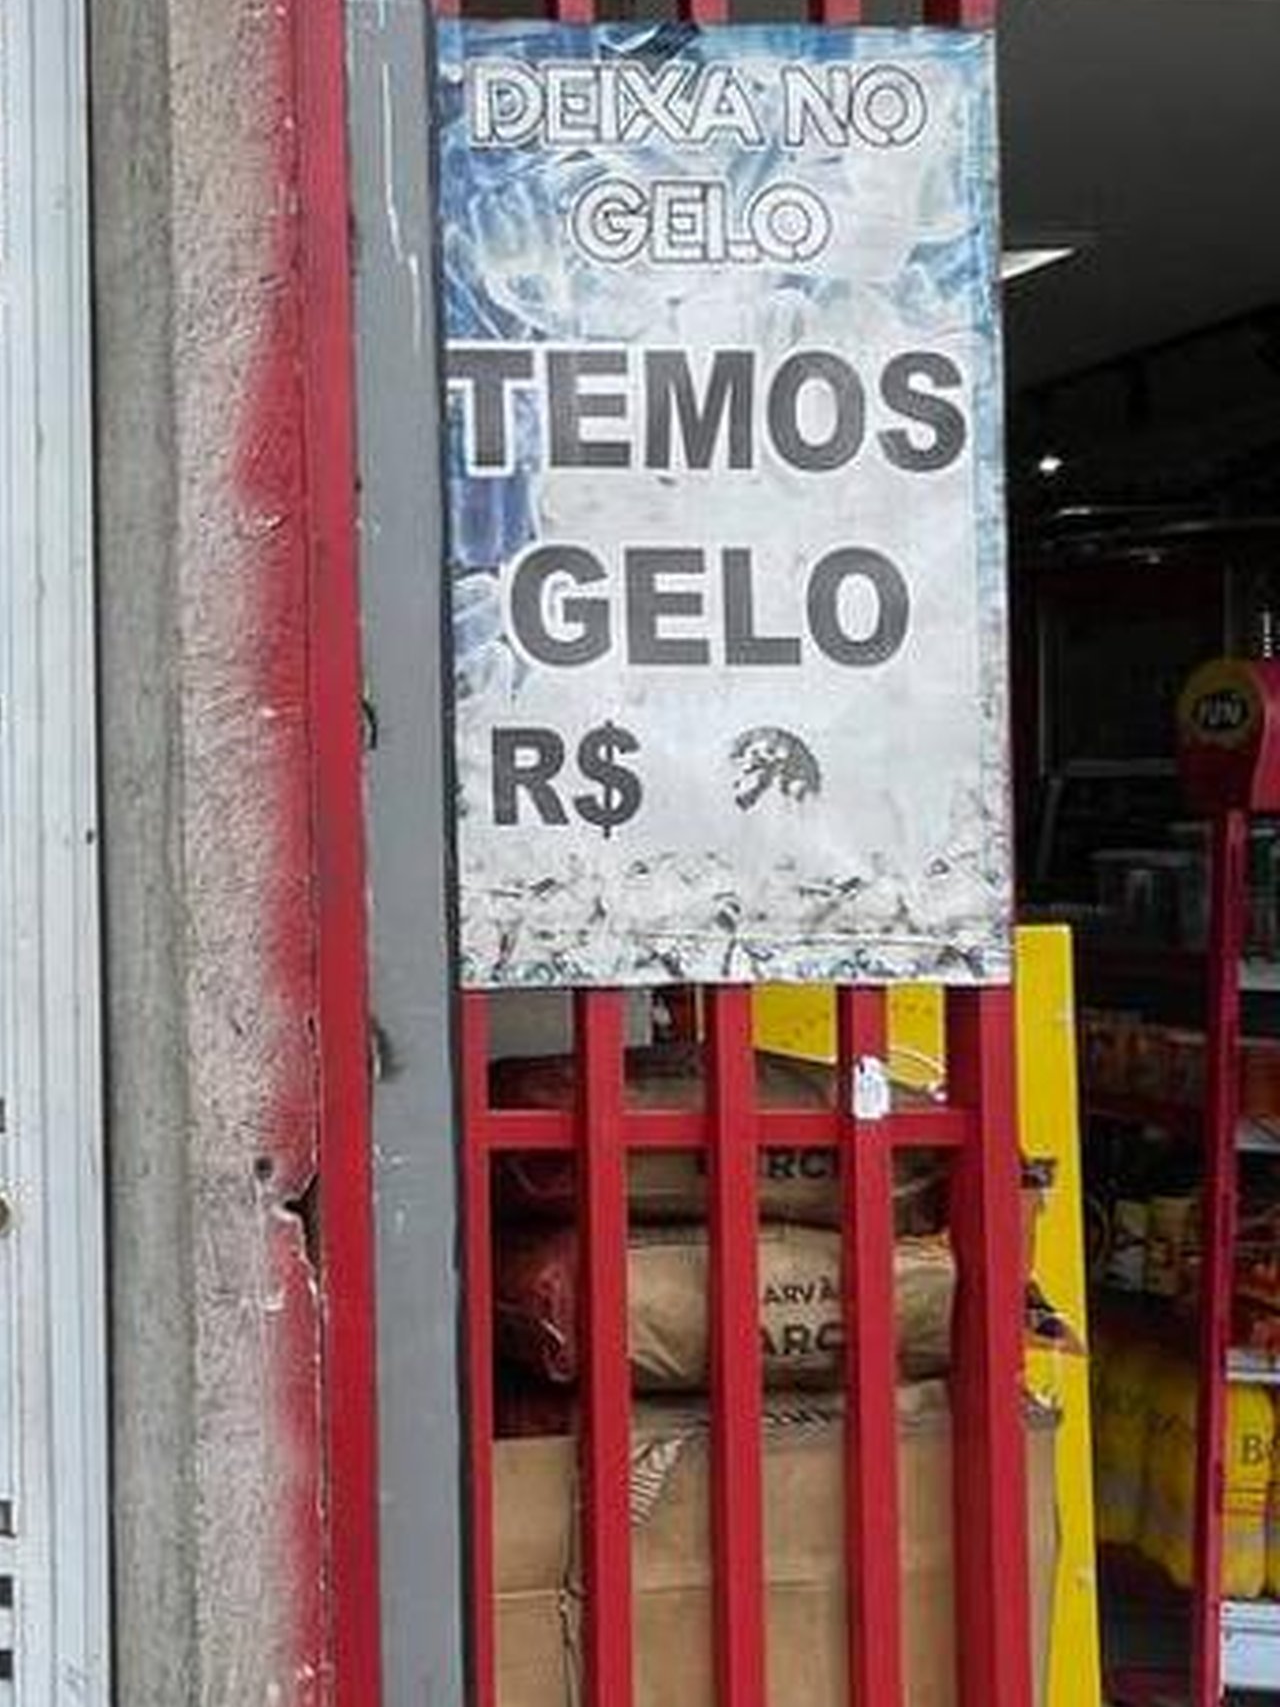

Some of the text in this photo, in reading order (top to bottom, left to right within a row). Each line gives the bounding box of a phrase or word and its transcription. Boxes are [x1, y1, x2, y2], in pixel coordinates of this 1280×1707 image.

[468, 62, 928, 149] DEIXA NO
[570, 179, 831, 264] GELO
[444, 348, 968, 474] TEMOS
[509, 545, 911, 668] GELO
[491, 720, 643, 839] R$
